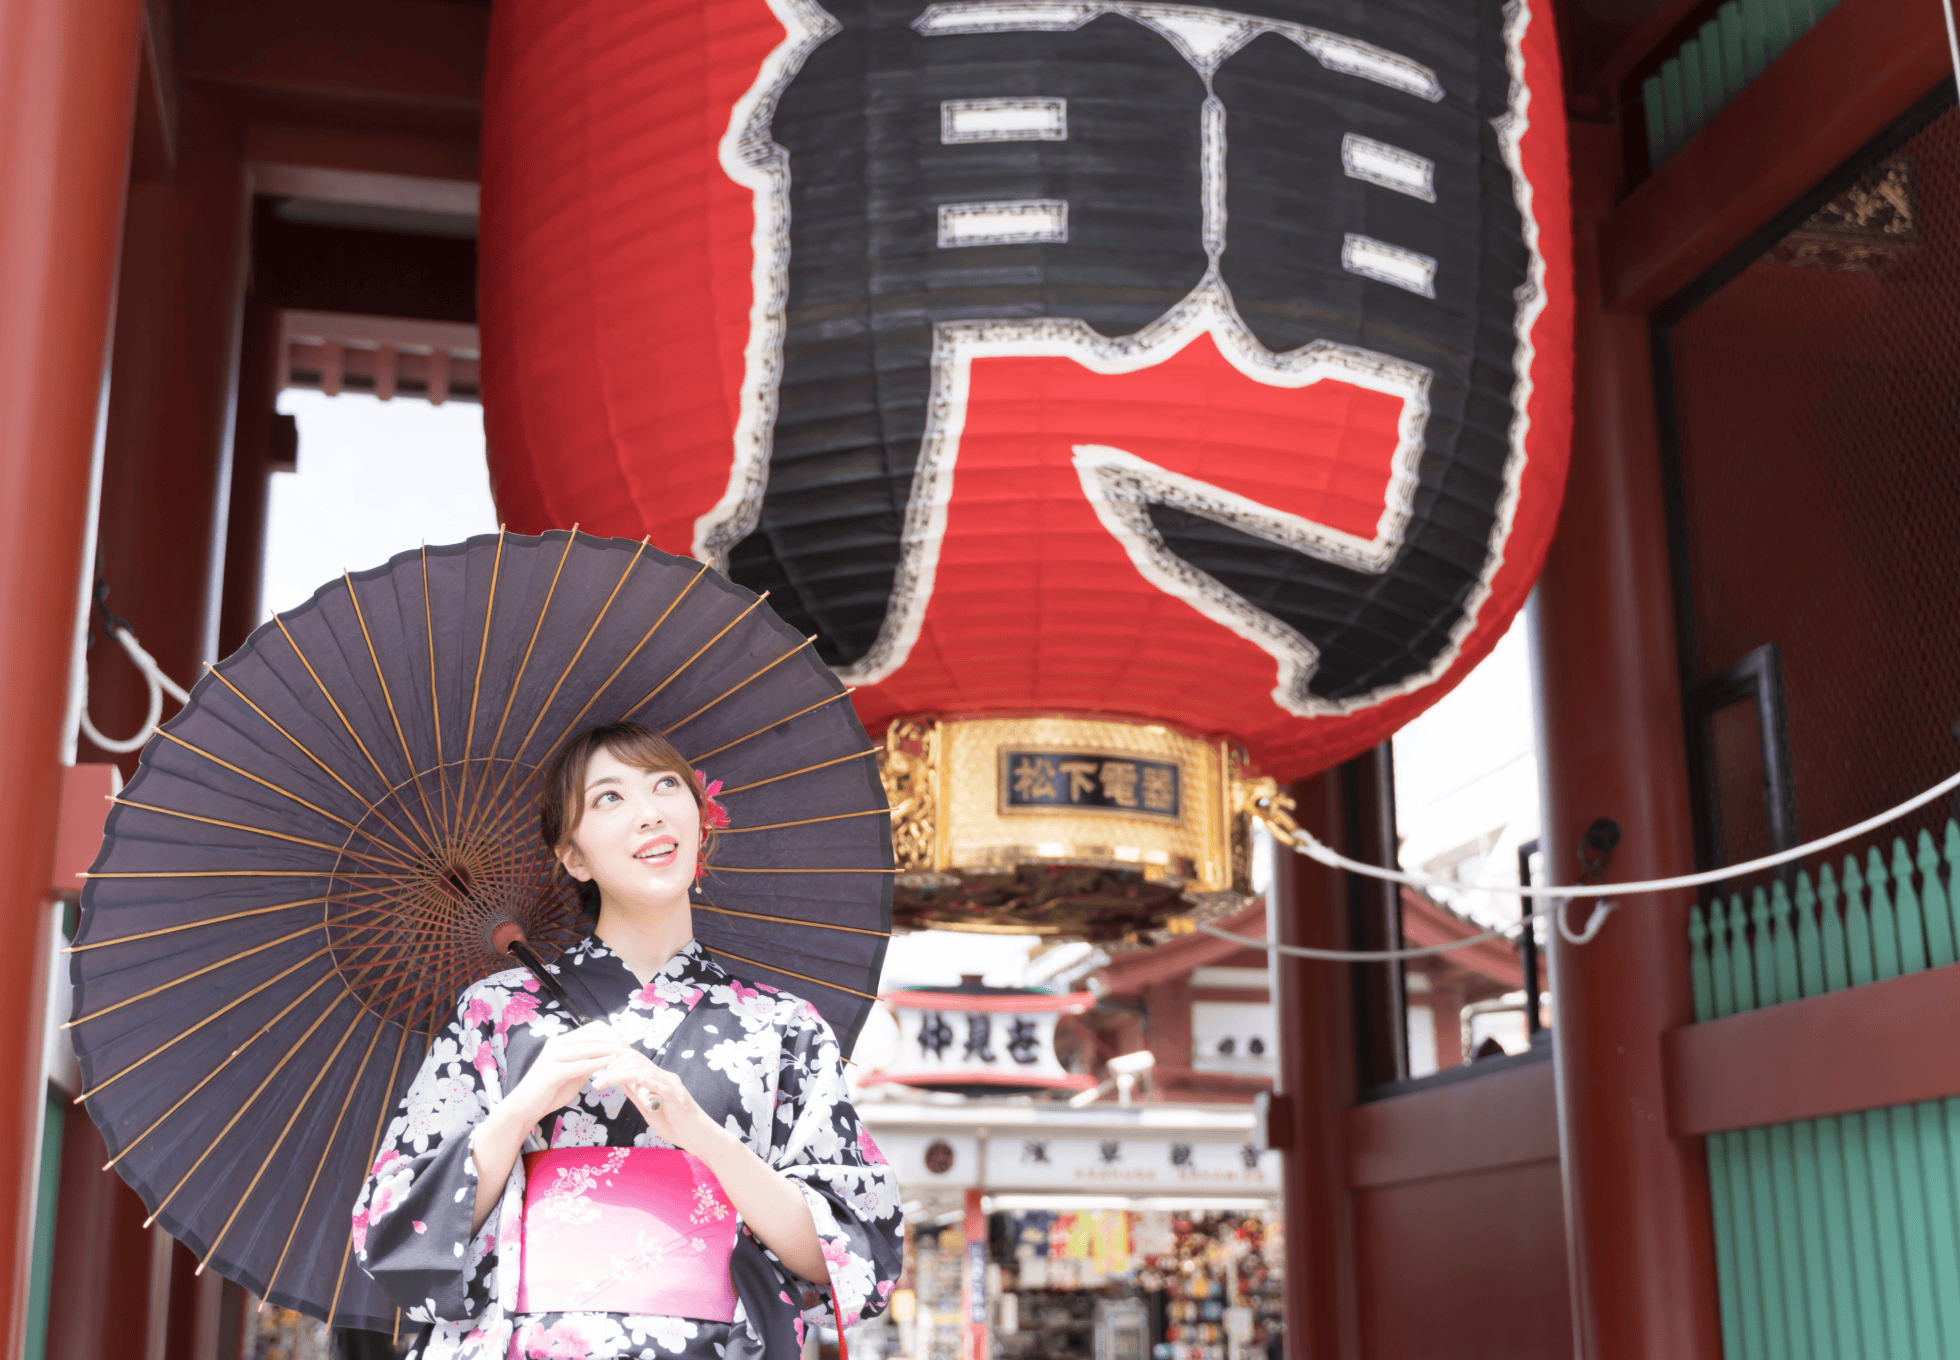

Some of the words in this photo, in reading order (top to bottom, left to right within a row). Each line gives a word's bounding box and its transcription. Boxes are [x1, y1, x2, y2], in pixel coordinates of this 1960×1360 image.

[692, 0, 1548, 720] 門
[1013, 757, 1174, 809] 松下電器
